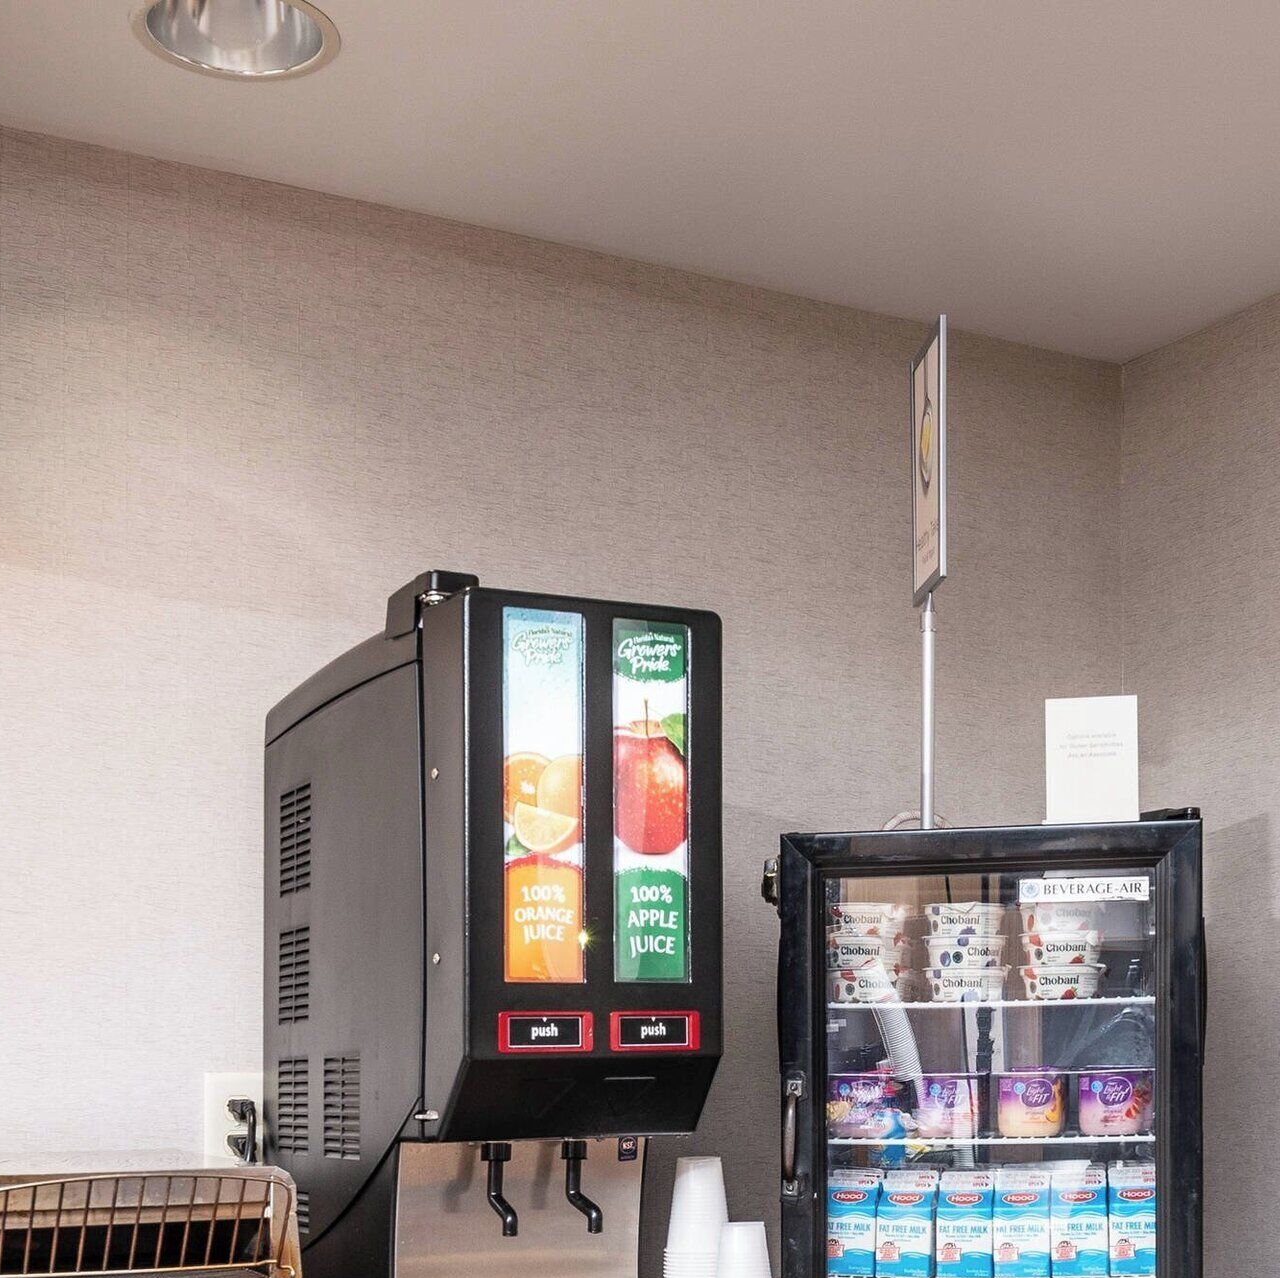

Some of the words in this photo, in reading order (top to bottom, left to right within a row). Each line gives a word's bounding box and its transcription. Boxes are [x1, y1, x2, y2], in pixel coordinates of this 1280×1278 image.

[618, 637, 681, 660] Growers
[630, 655, 670, 674] Pride
[521, 884, 566, 903] 100%
[1043, 882, 1142, 895] BEVERAGE-AIR
[630, 884, 673, 904] 100%
[513, 906, 575, 925] ORANGE
[627, 908, 679, 930] APPLE
[844, 915, 882, 924] Chobani
[941, 915, 980, 925] Chobani
[523, 924, 566, 944] JUICE
[629, 935, 676, 959] JUICE
[840, 946, 880, 956] Chobani
[1046, 943, 1087, 952] Chobani
[943, 978, 982, 988] Chobani
[1039, 975, 1080, 986] Chobani
[531, 1023, 559, 1040] push
[640, 1022, 667, 1039] push
[1032, 1093, 1050, 1103] FIT
[1110, 1091, 1128, 1101] FIT
[836, 1192, 864, 1200] Hood
[1123, 1190, 1151, 1198] Hood
[836, 1222, 852, 1231] FREE
[854, 1222, 871, 1232] MILK
[879, 1224, 890, 1232] FAT
[892, 1224, 908, 1233] FREE
[910, 1225, 927, 1234] MILK
[939, 1225, 950, 1233] FAT
[953, 1225, 968, 1234] FREE
[971, 1225, 988, 1234] MILK
[1010, 1224, 1026, 1233] FREE
[1028, 1224, 1045, 1233] MILK
[1067, 1222, 1083, 1231] FREE
[1086, 1223, 1104, 1231] MILK
[1112, 1222, 1124, 1230] FAT
[1126, 1221, 1141, 1230] FREE
